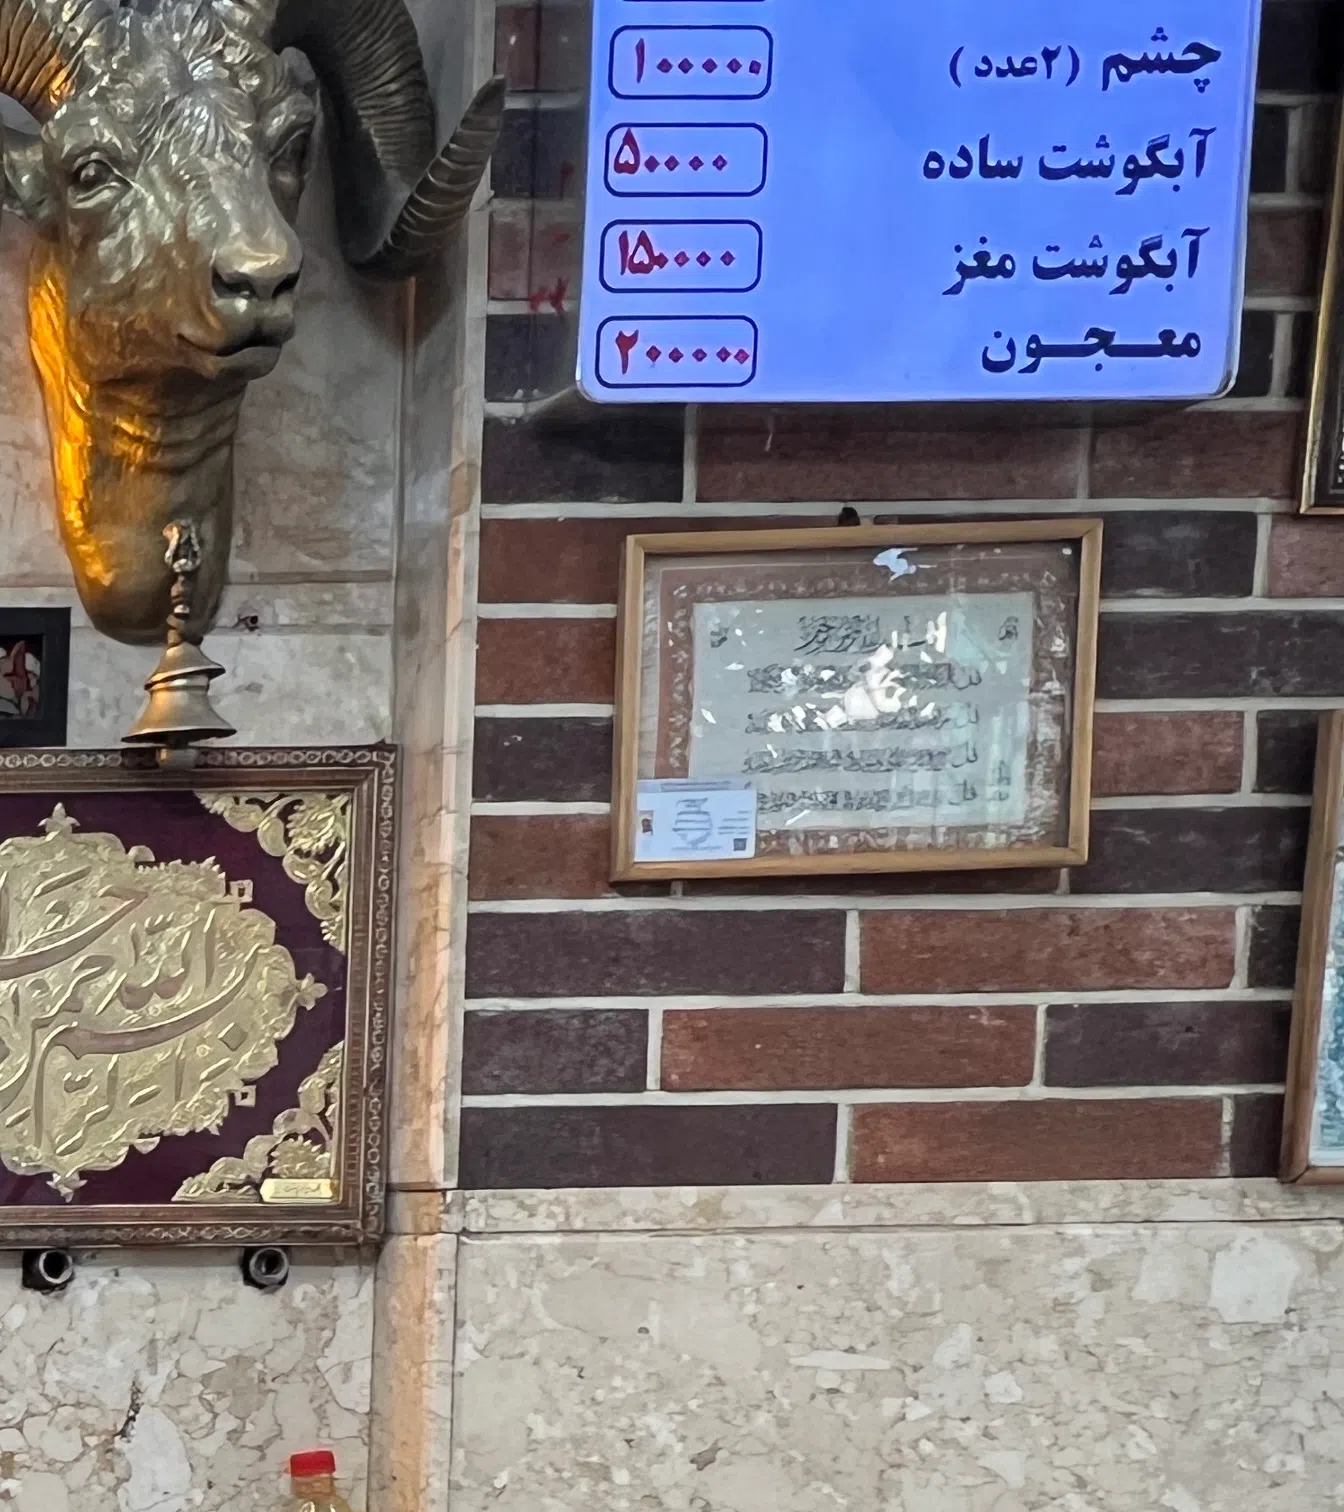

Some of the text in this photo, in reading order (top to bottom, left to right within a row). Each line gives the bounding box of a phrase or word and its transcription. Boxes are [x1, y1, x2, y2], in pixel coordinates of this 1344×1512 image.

[1100, 26, 1223, 93] چشم
[922, 127, 1217, 195] آبگوشت ساده
[943, 227, 1210, 296] آبگوشت مغز
